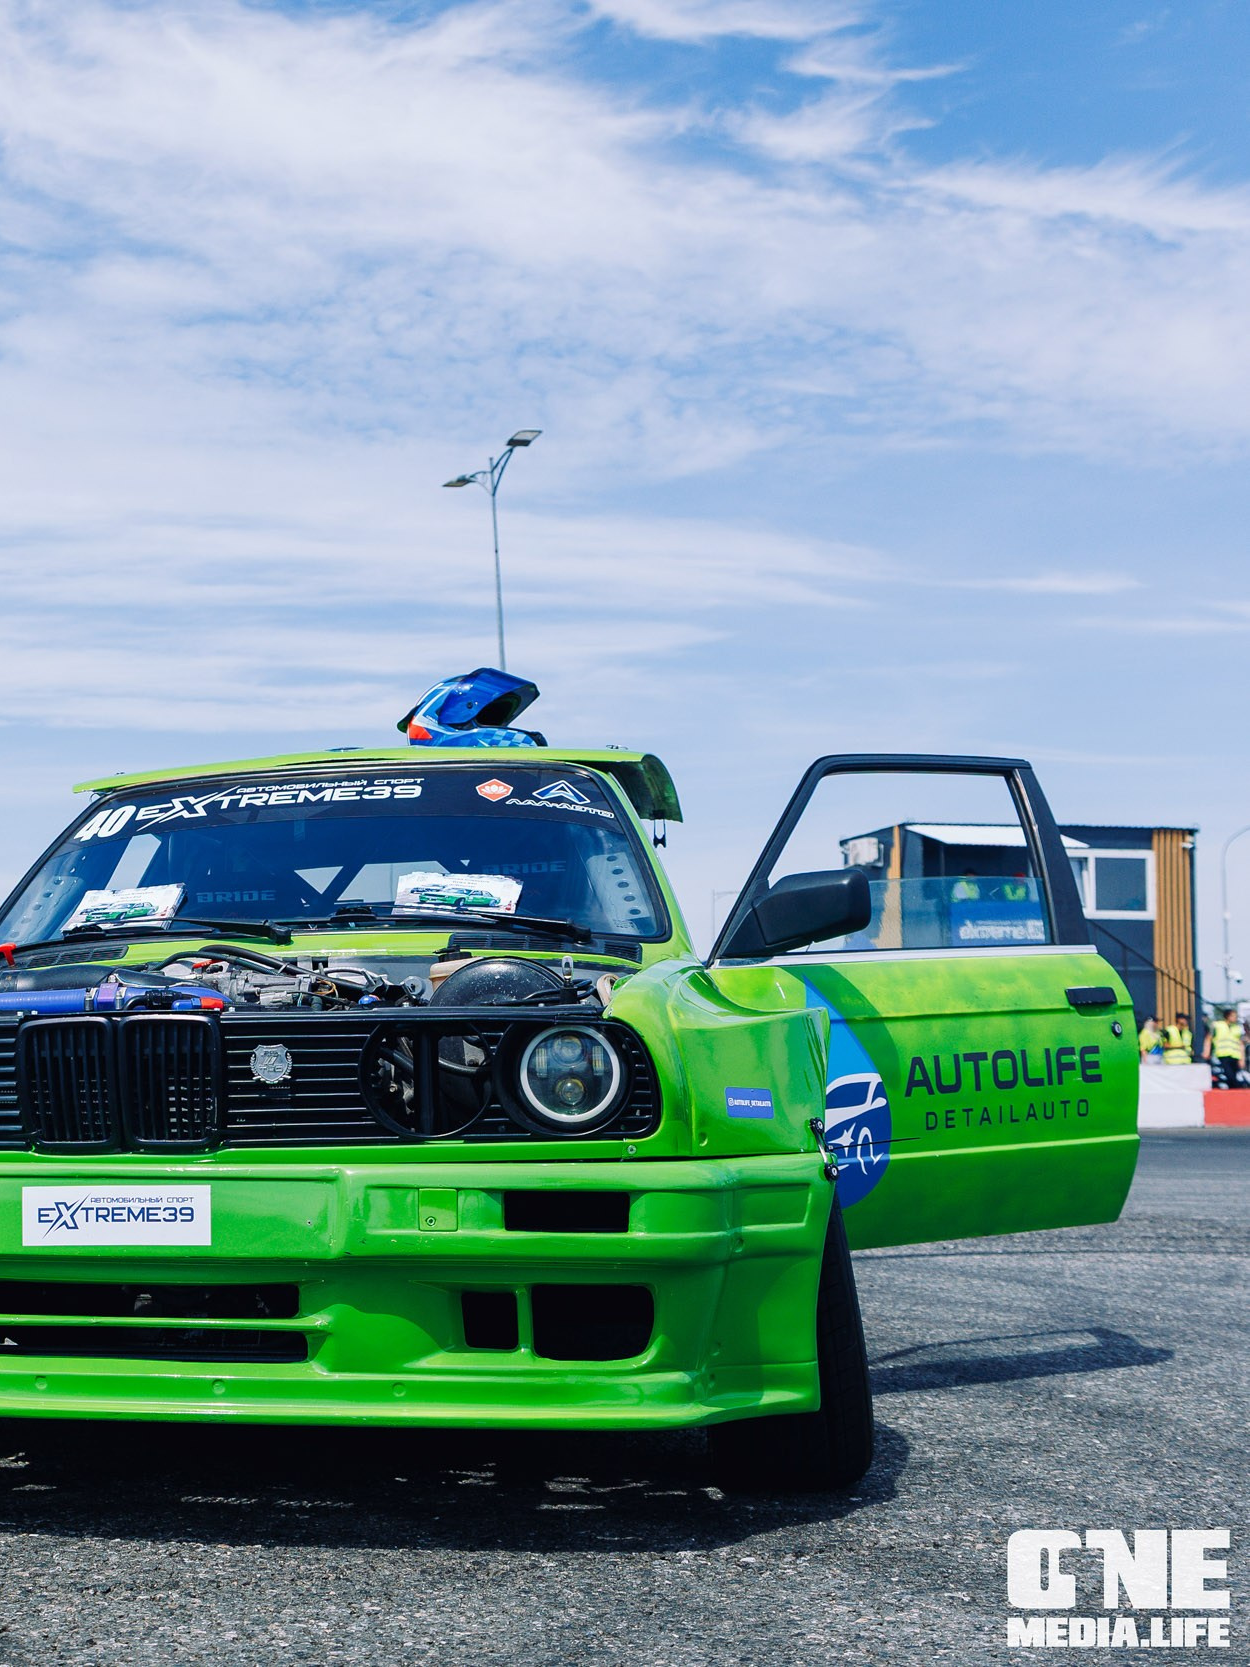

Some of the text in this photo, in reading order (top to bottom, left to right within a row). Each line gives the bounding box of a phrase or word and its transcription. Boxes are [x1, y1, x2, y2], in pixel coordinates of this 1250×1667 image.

[236, 777, 425, 794] АВТОМОБИЛЬНЫЙ СПОРТ
[73, 805, 137, 842] 40
[135, 785, 423, 831] EXTREME39
[481, 860, 567, 875] BRIDE
[195, 889, 276, 904] BRIDE
[904, 1045, 1103, 1098] AUTOLIFE
[925, 1098, 1090, 1131] DETAILAUTO
[37, 1192, 195, 1239] EXTREME39
[90, 1195, 195, 1204] АВТОМОБИЛЬНЫЙ СПОРТ
